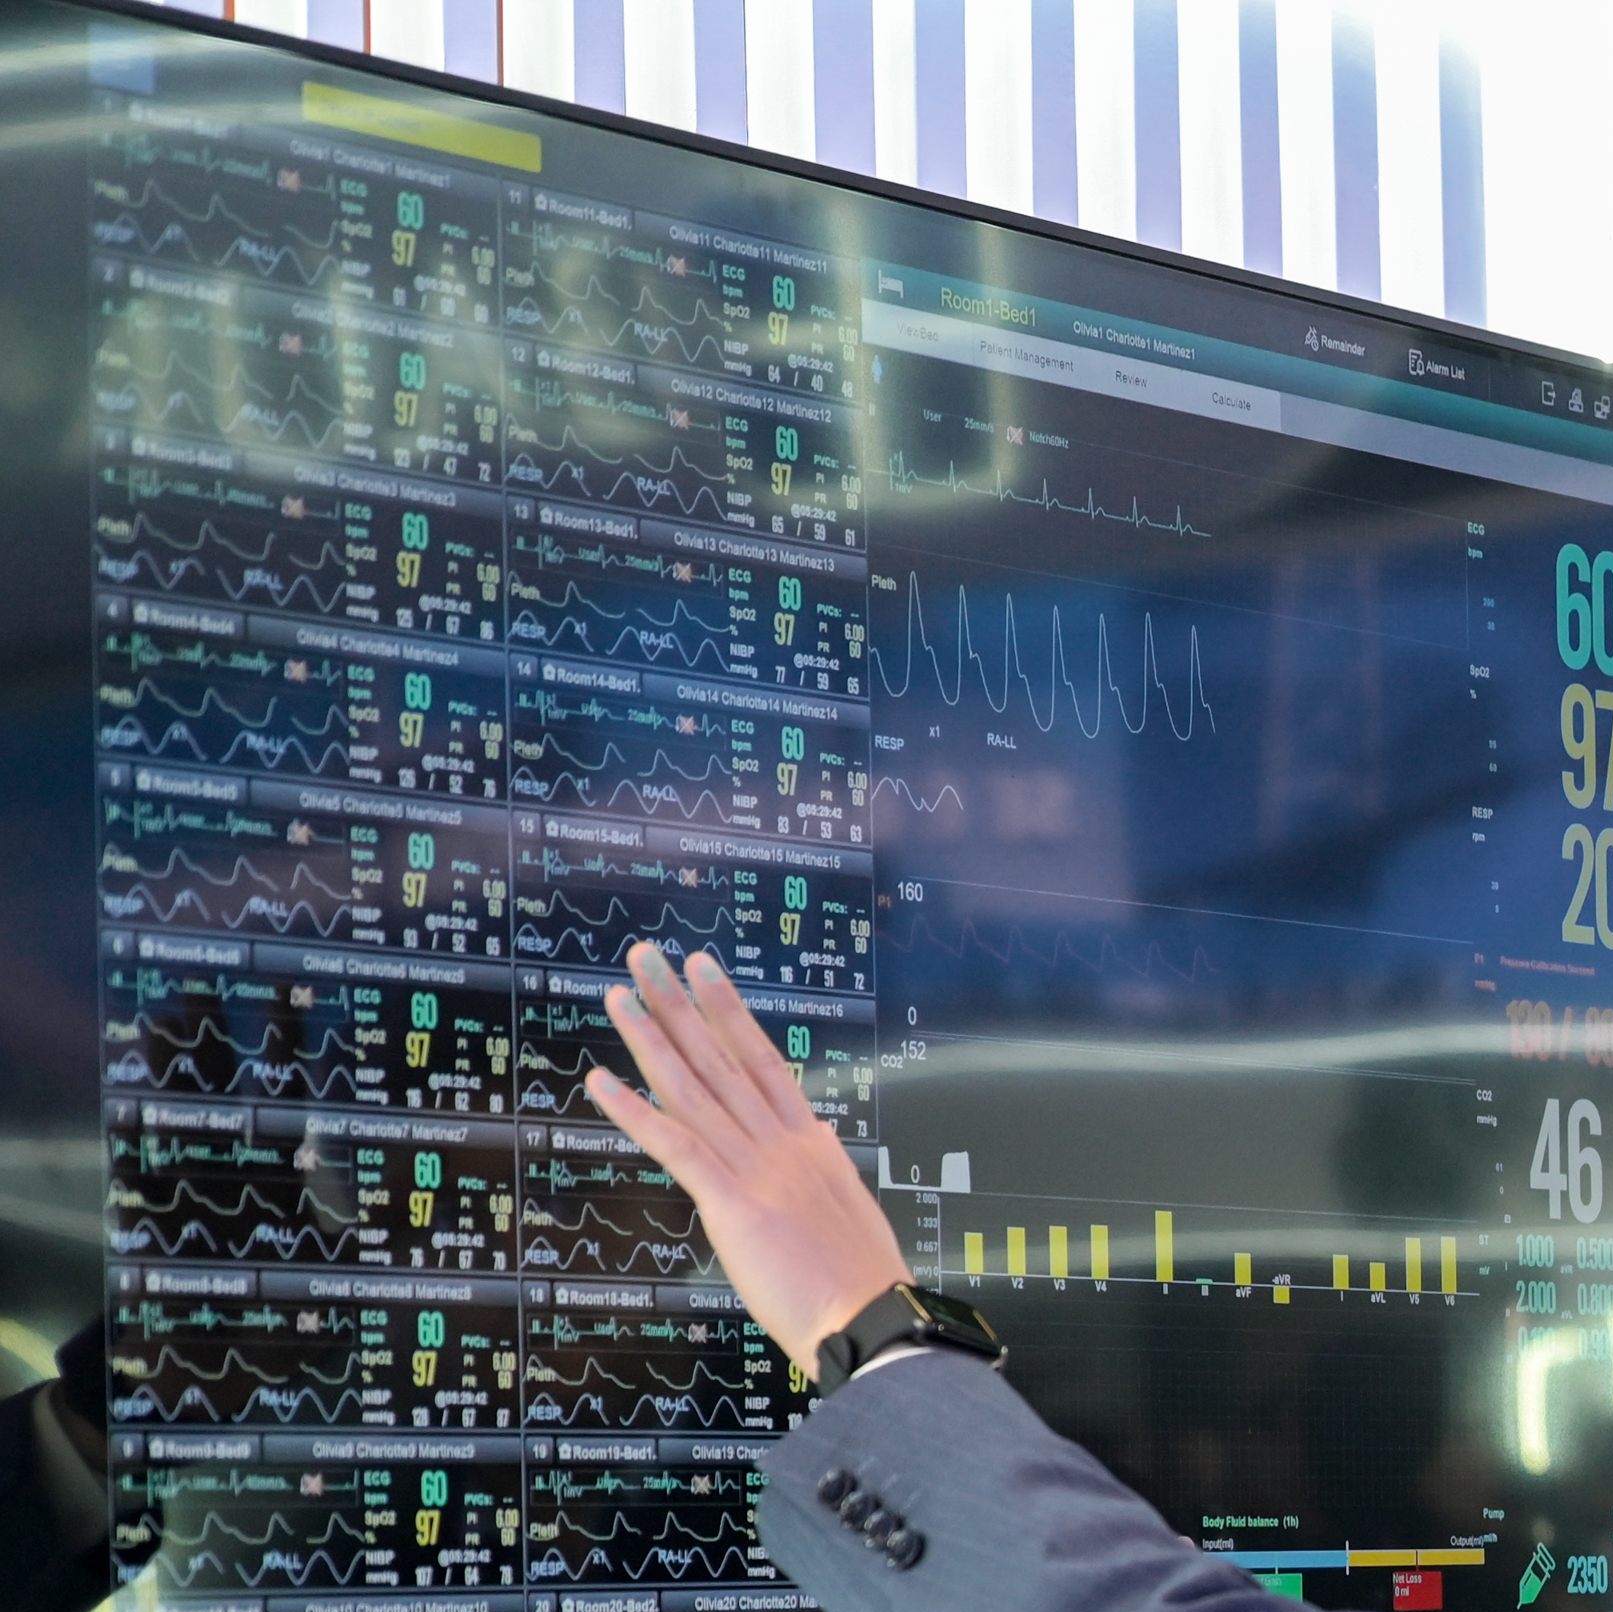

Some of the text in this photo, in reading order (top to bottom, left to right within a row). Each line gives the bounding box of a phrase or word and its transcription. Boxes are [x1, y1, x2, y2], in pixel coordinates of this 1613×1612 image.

[397, 191, 424, 230] 60
[391, 230, 417, 267] 97
[669, 226, 827, 273] Olivia11 Charlotte11 Martinez11
[722, 264, 746, 281] ECG
[772, 275, 795, 311] 60
[941, 286, 1037, 327] Room1-Bed1
[768, 312, 789, 346] 97
[897, 321, 939, 342] ViewBed
[1073, 320, 1196, 360] Olivia1 Charlotte1 Martinez1
[1321, 334, 1366, 356] Remainder
[980, 340, 1074, 373] Patient Management
[1115, 370, 1147, 388] Review
[1426, 360, 1465, 381] Alarm List
[1212, 391, 1251, 411] Calculate
[923, 408, 942, 423] User
[964, 417, 994, 434] 25mm/s
[1029, 430, 1069, 449] Notch60Hz
[1467, 521, 1485, 536] ECG
[674, 532, 835, 573] Olivia13 Charlotte13 Martinez13
[1468, 547, 1483, 559] bpm
[728, 568, 751, 584] ECG
[871, 574, 897, 591] Pleth
[779, 576, 801, 611] 60
[729, 606, 756, 623] SpO2
[774, 612, 795, 646] 97
[845, 623, 865, 642] 6.00
[730, 643, 755, 659] NIBP
[1470, 664, 1490, 678] SpO2
[874, 735, 905, 751] RESP
[987, 732, 1017, 749] RA-LL
[1472, 806, 1493, 819] RESP
[559, 823, 644, 847] Room15-Bed1.
[1472, 832, 1486, 843] rpm
[680, 838, 840, 870] Olivia15 Charlotte15 Martinez15
[897, 881, 924, 902] 160
[908, 1006, 917, 1025] 0
[900, 1041, 926, 1060] 152
[880, 1054, 903, 1068] CO2
[1476, 1089, 1492, 1102] CO2
[1477, 1115, 1497, 1127] mmHg
[1530, 1098, 1603, 1223] 46
[911, 1165, 920, 1184] 0
[1479, 1234, 1489, 1245] ST
[1516, 1234, 1555, 1268] 1.000
[570, 1291, 654, 1308] Room18-Bed1.
[969, 1277, 981, 1288] V1
[1011, 1278, 1023, 1289] V2
[1054, 1279, 1066, 1291] V3
[1095, 1280, 1107, 1292] V4
[1236, 1286, 1252, 1298] aVF
[1371, 1292, 1386, 1304] aVL
[1516, 1280, 1556, 1314] 2.000
[689, 1294, 732, 1309] Olivia18
[421, 1470, 448, 1507] 60
[1202, 1515, 1299, 1529] Body Fluid balance (1h)
[1483, 1508, 1505, 1521] Pump
[415, 1510, 441, 1546] 97
[1450, 1534, 1484, 1548] Output(ml)
[1406, 1573, 1422, 1584] Loss
[1567, 1555, 1609, 1594] 2350
[694, 1594, 797, 1612] Olivia20 Charlotte20
